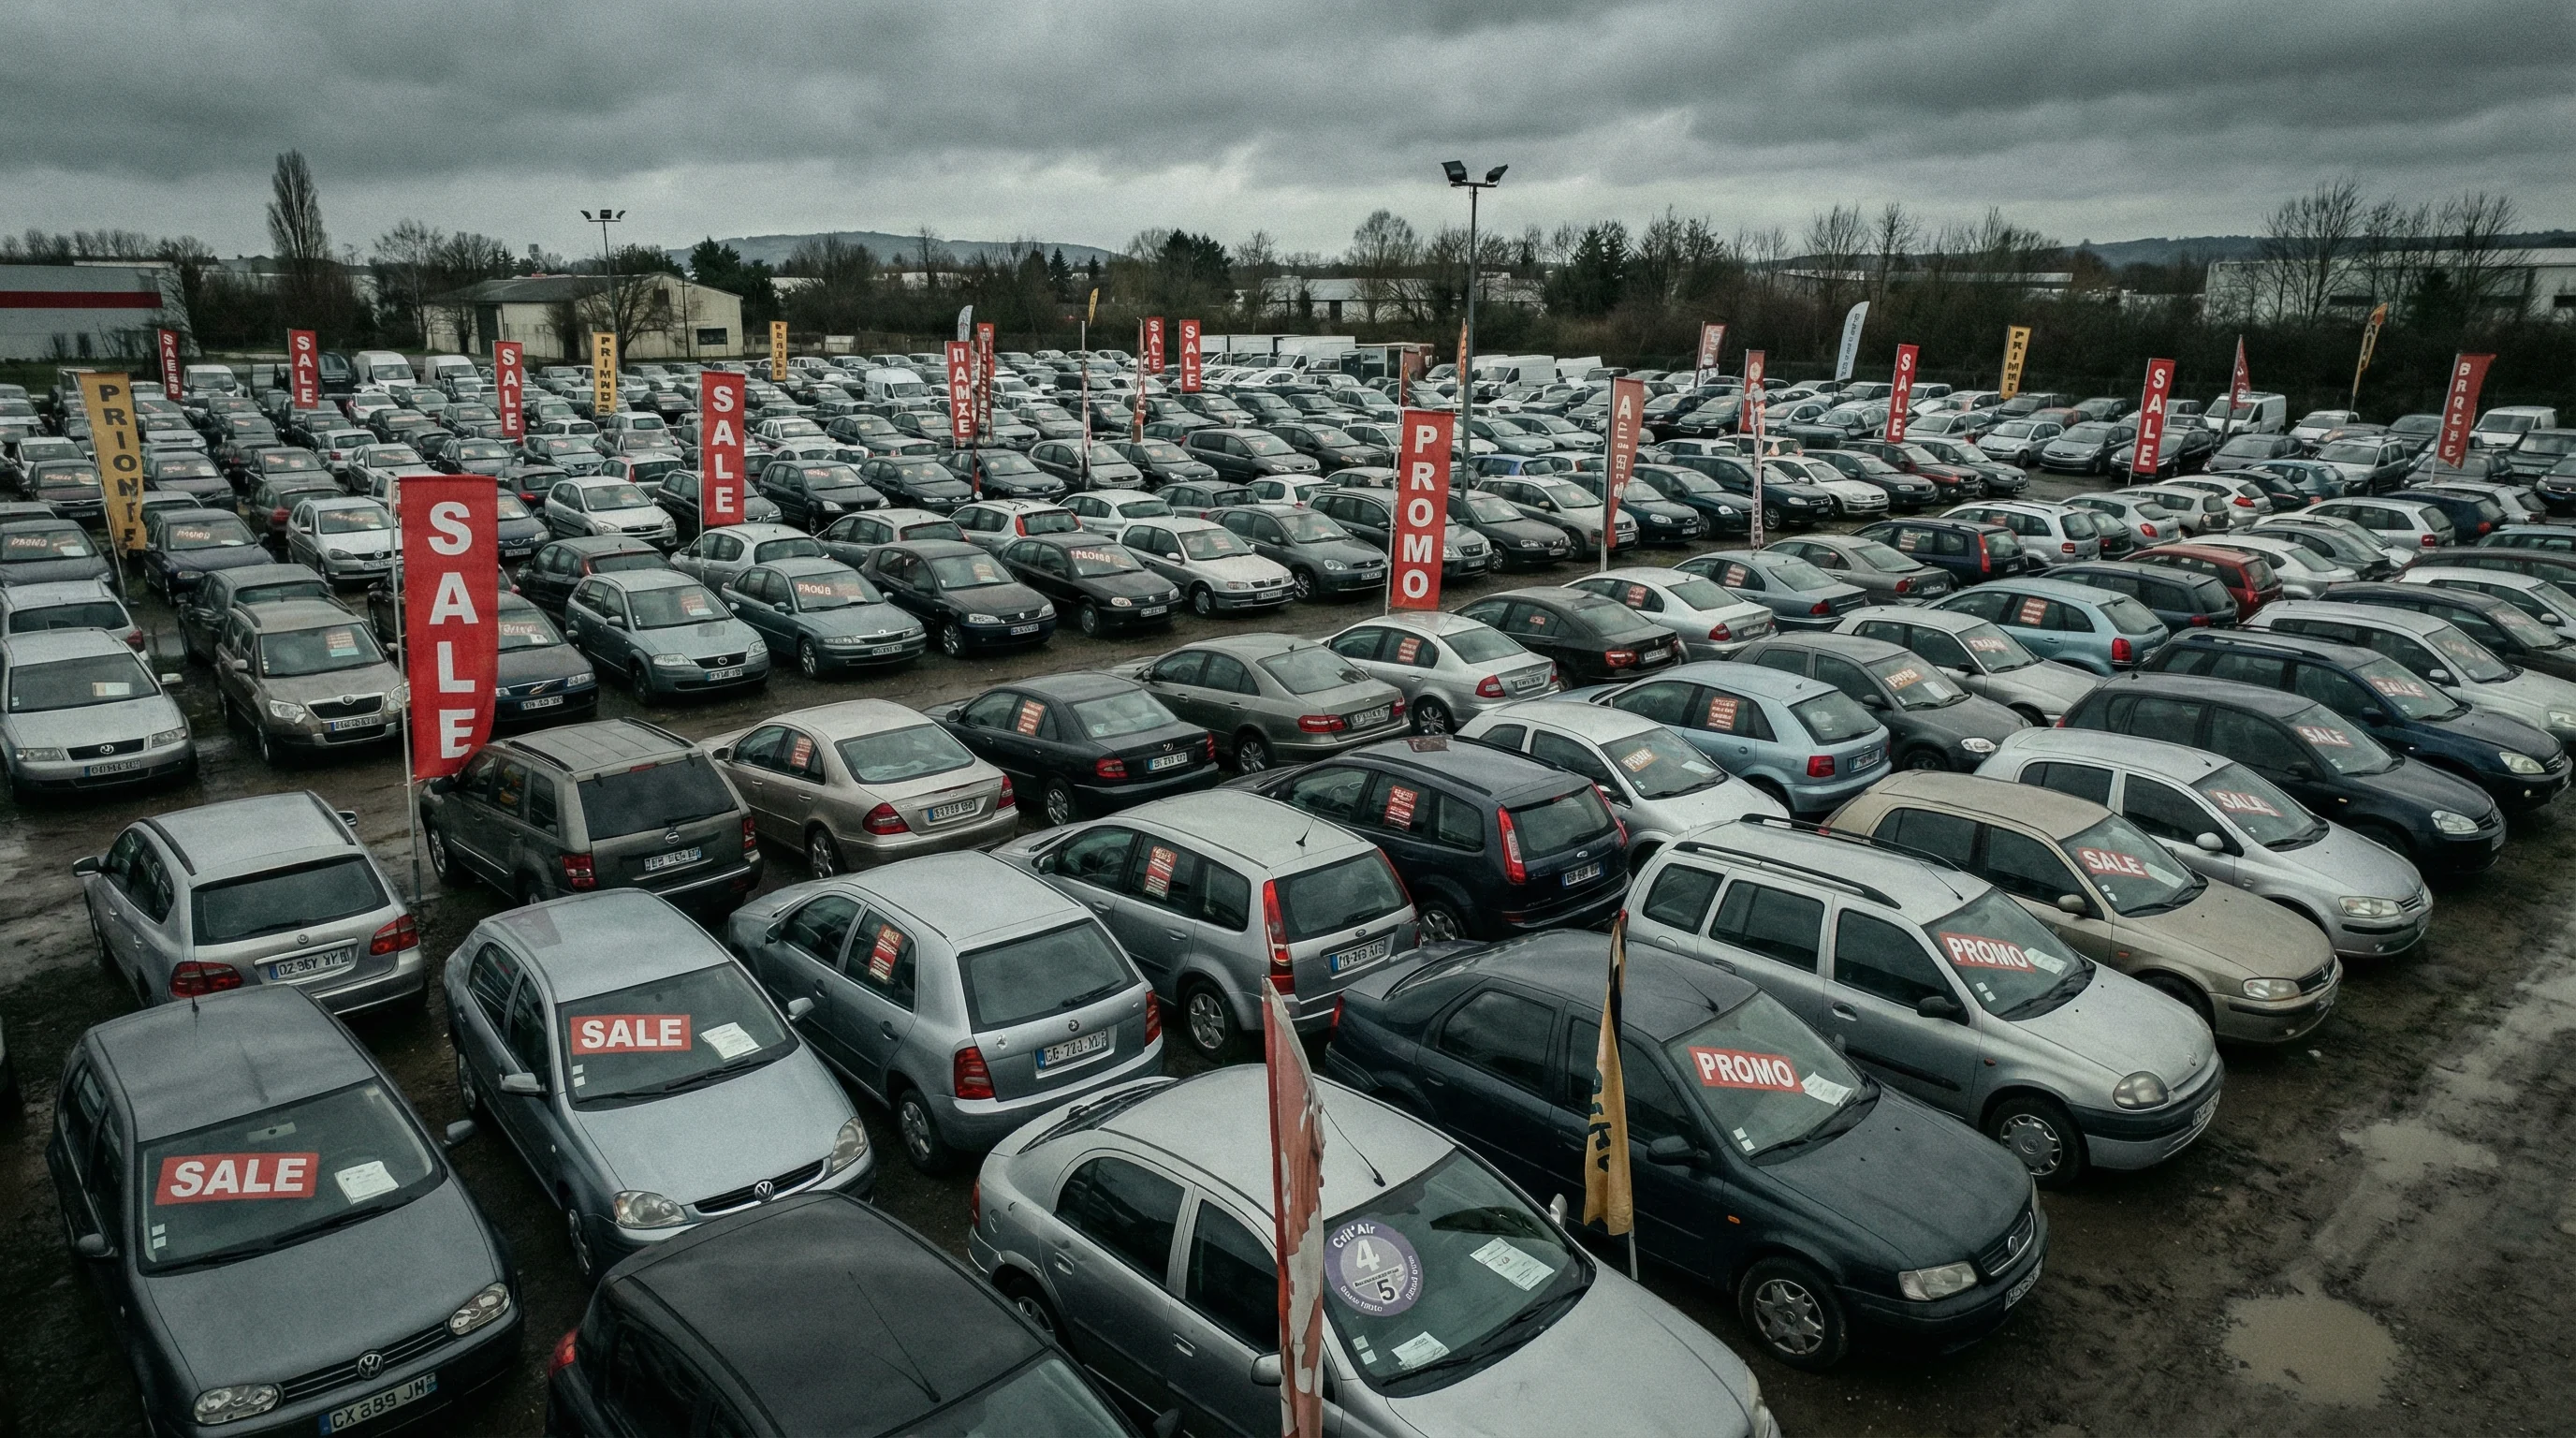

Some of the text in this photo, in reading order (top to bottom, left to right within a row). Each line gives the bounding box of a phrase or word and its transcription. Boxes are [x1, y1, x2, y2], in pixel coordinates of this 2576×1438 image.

[297, 335, 313, 404] SALE
[1149, 320, 1161, 370] SALE
[1185, 325, 1197, 387] SALE
[502, 348, 519, 431] SALE
[1891, 353, 1911, 436] SALE
[2138, 368, 2166, 466] SALE
[711, 386, 737, 513] SALE
[1402, 424, 1438, 599] PROMO
[427, 501, 479, 759] SALE
[2302, 728, 2350, 745] SALE
[2082, 850, 2146, 876] SALE
[1945, 936, 2029, 970] PROMO
[580, 1019, 682, 1049] SALE
[1695, 1050, 1796, 1089] PROMO
[168, 1157, 308, 1198] SALE
[1355, 1239, 1381, 1271] 4
[1376, 1278, 1396, 1301] 5
